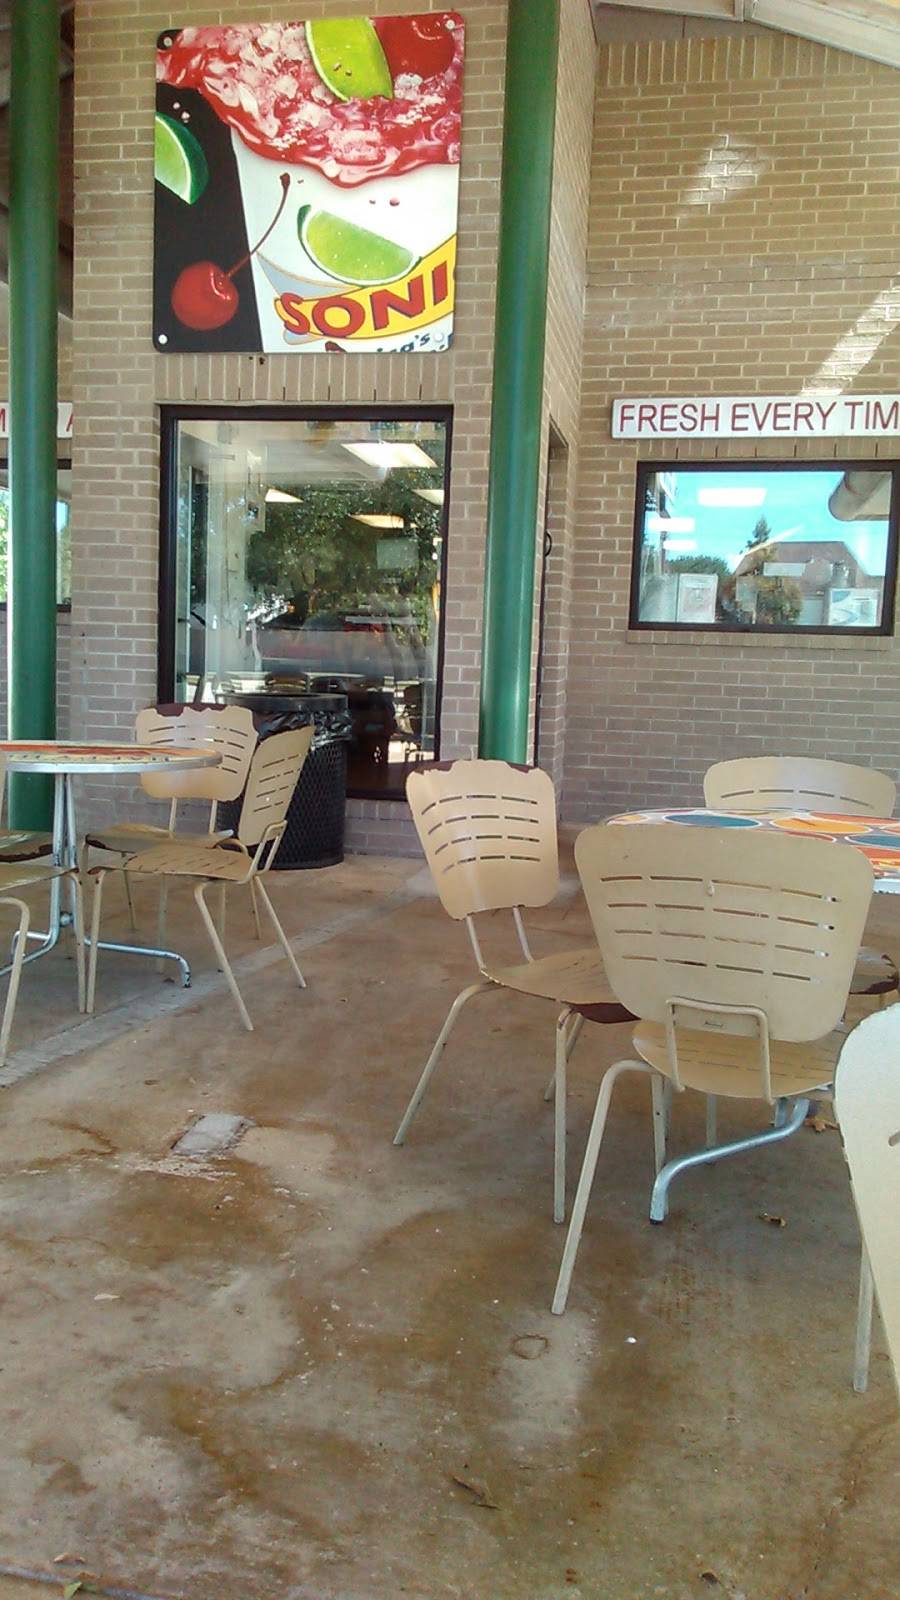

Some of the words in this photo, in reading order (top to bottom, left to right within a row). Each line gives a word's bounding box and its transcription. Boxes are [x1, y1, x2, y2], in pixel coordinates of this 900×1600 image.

[280, 260, 454, 338] SONI
[619, 403, 720, 432] FRESH
[731, 401, 837, 432] EVERY
[844, 400, 899, 430] TIM
